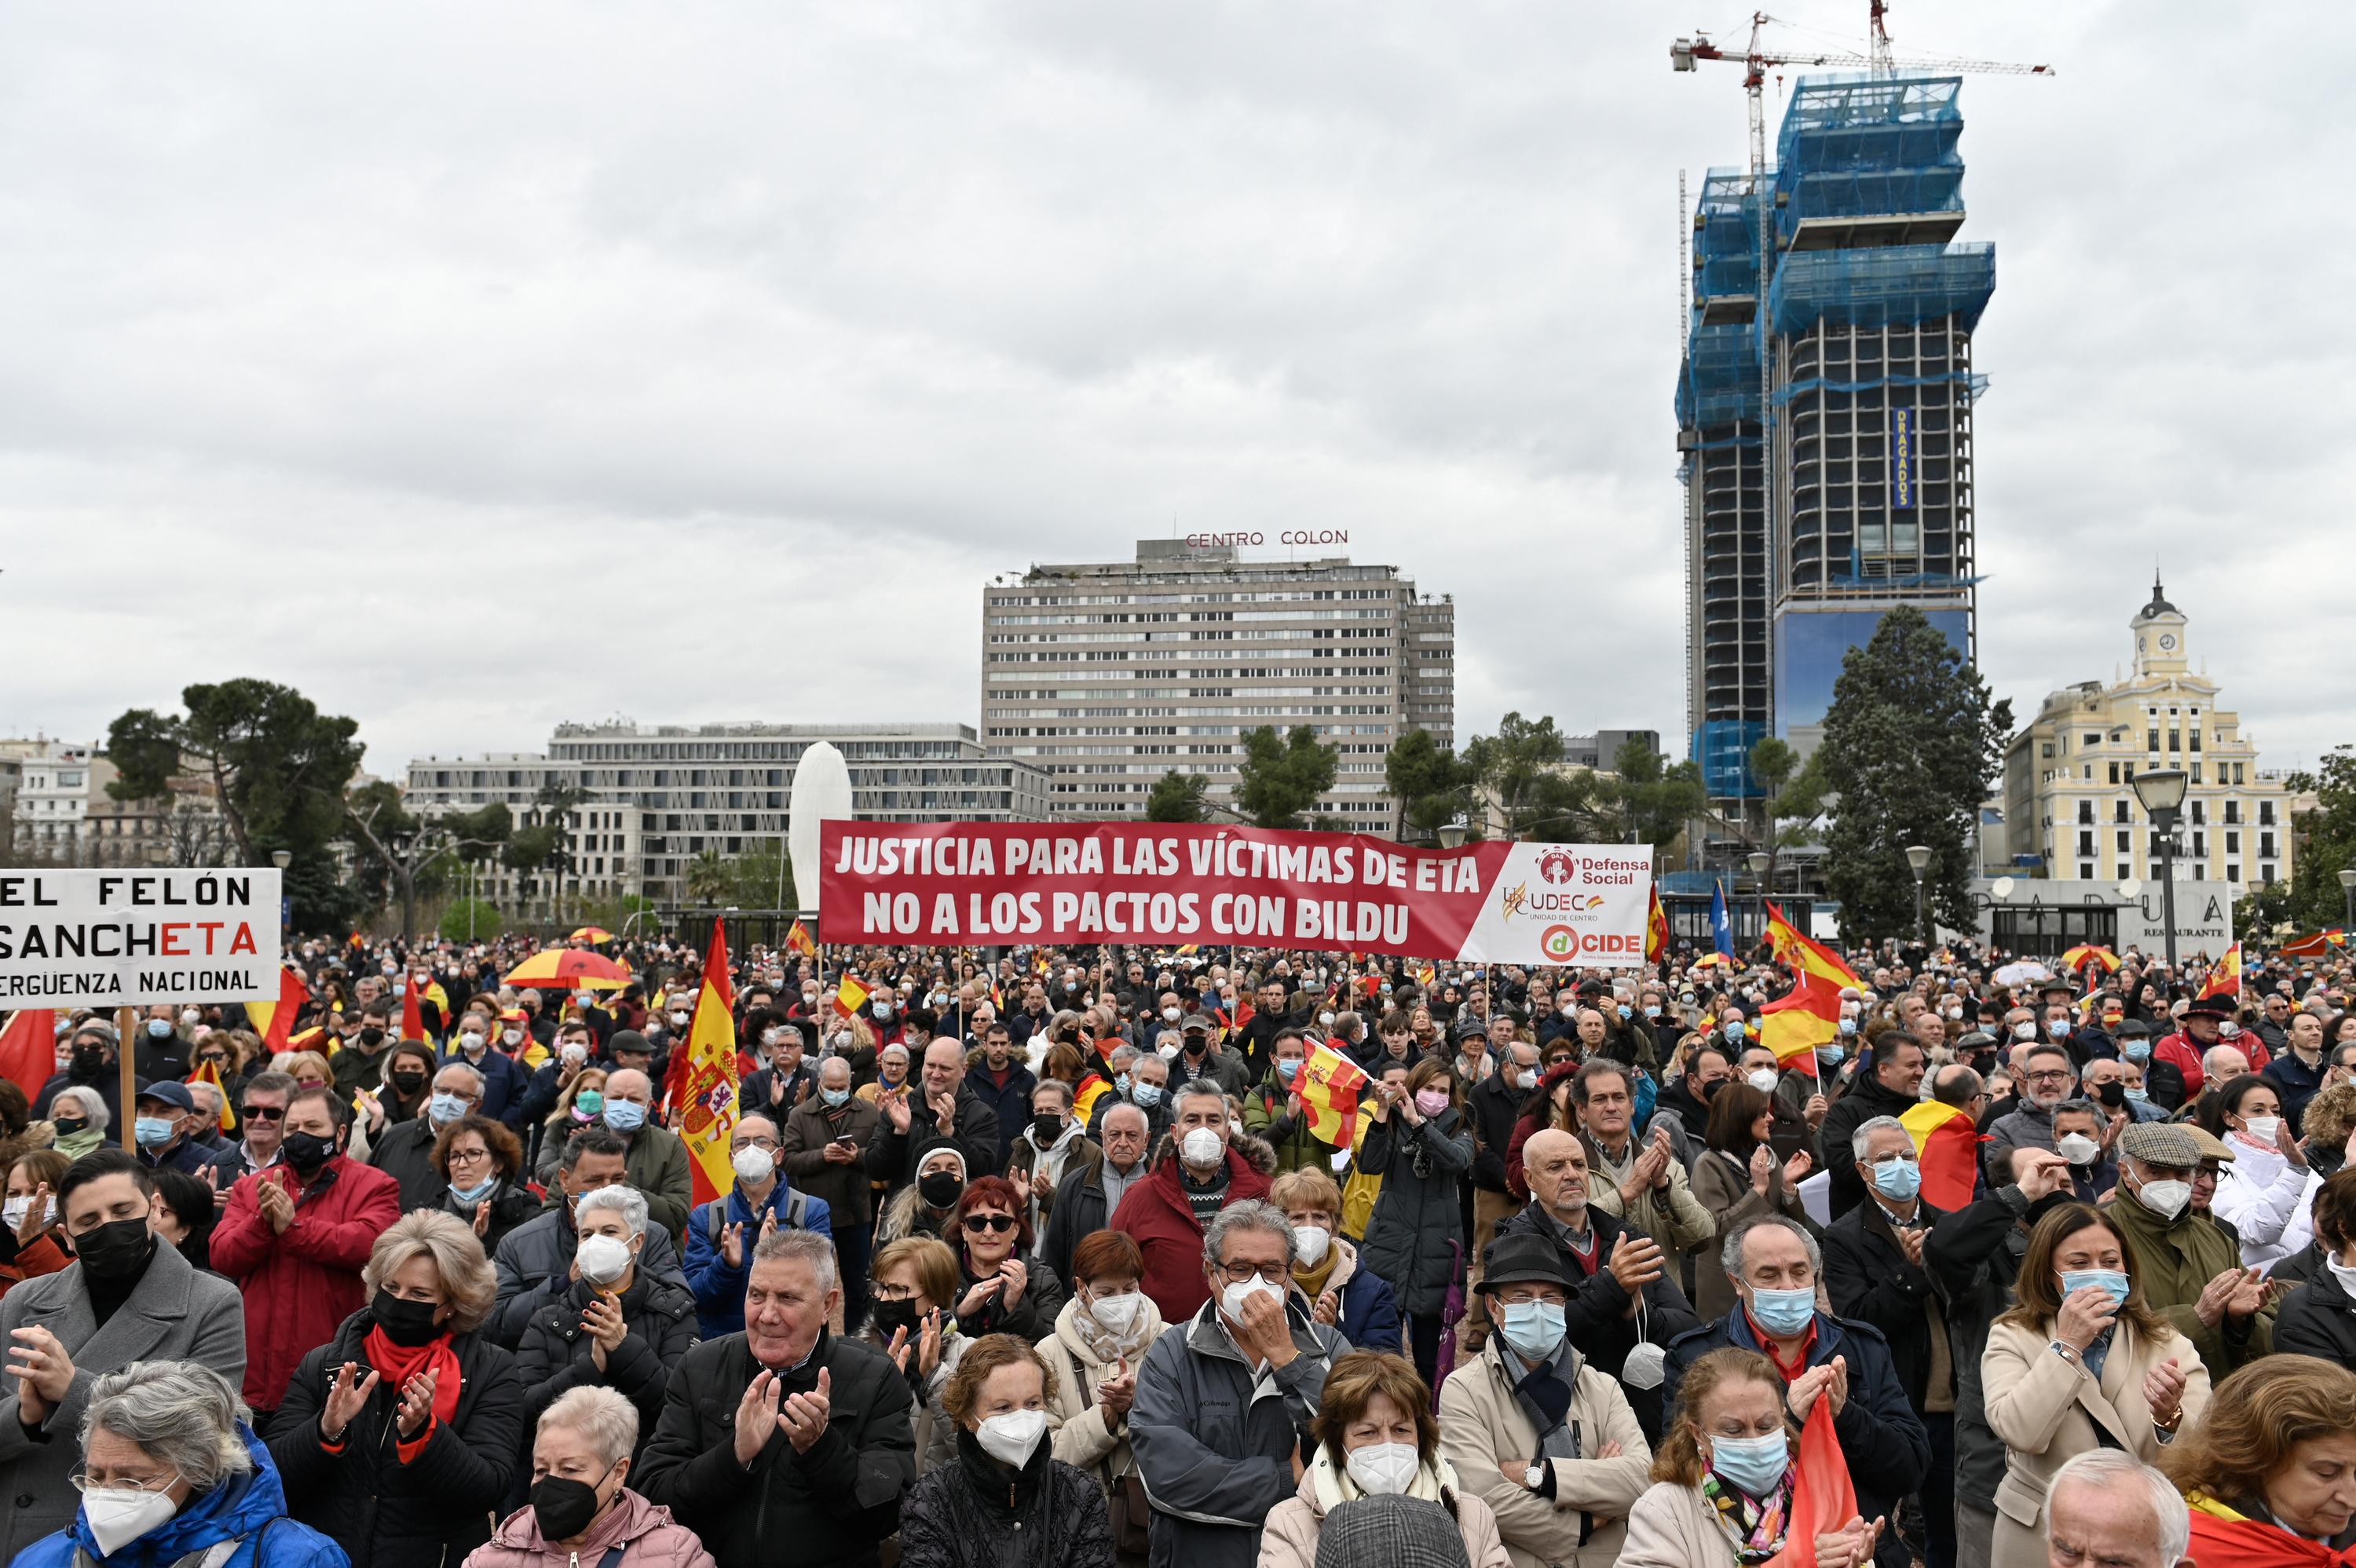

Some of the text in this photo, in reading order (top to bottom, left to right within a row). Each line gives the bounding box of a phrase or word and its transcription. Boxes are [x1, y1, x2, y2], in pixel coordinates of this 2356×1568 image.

[1897, 410, 1908, 506] DRAGADOS
[1186, 530, 1348, 547] CENTRO COLON
[836, 832, 1480, 893] JUSTICIA PARA LAS VÍCTIMAS DE ETA
[1582, 858, 1648, 871] Defensa
[1582, 872, 1633, 885] Social
[0, 872, 250, 906] EL FELÓN
[1531, 894, 1584, 911] UDEC
[864, 892, 1408, 944] NO A LOS PACTOS CON BILDU
[1582, 934, 1641, 952] CIDE
[139, 970, 258, 992] NACIONAL
